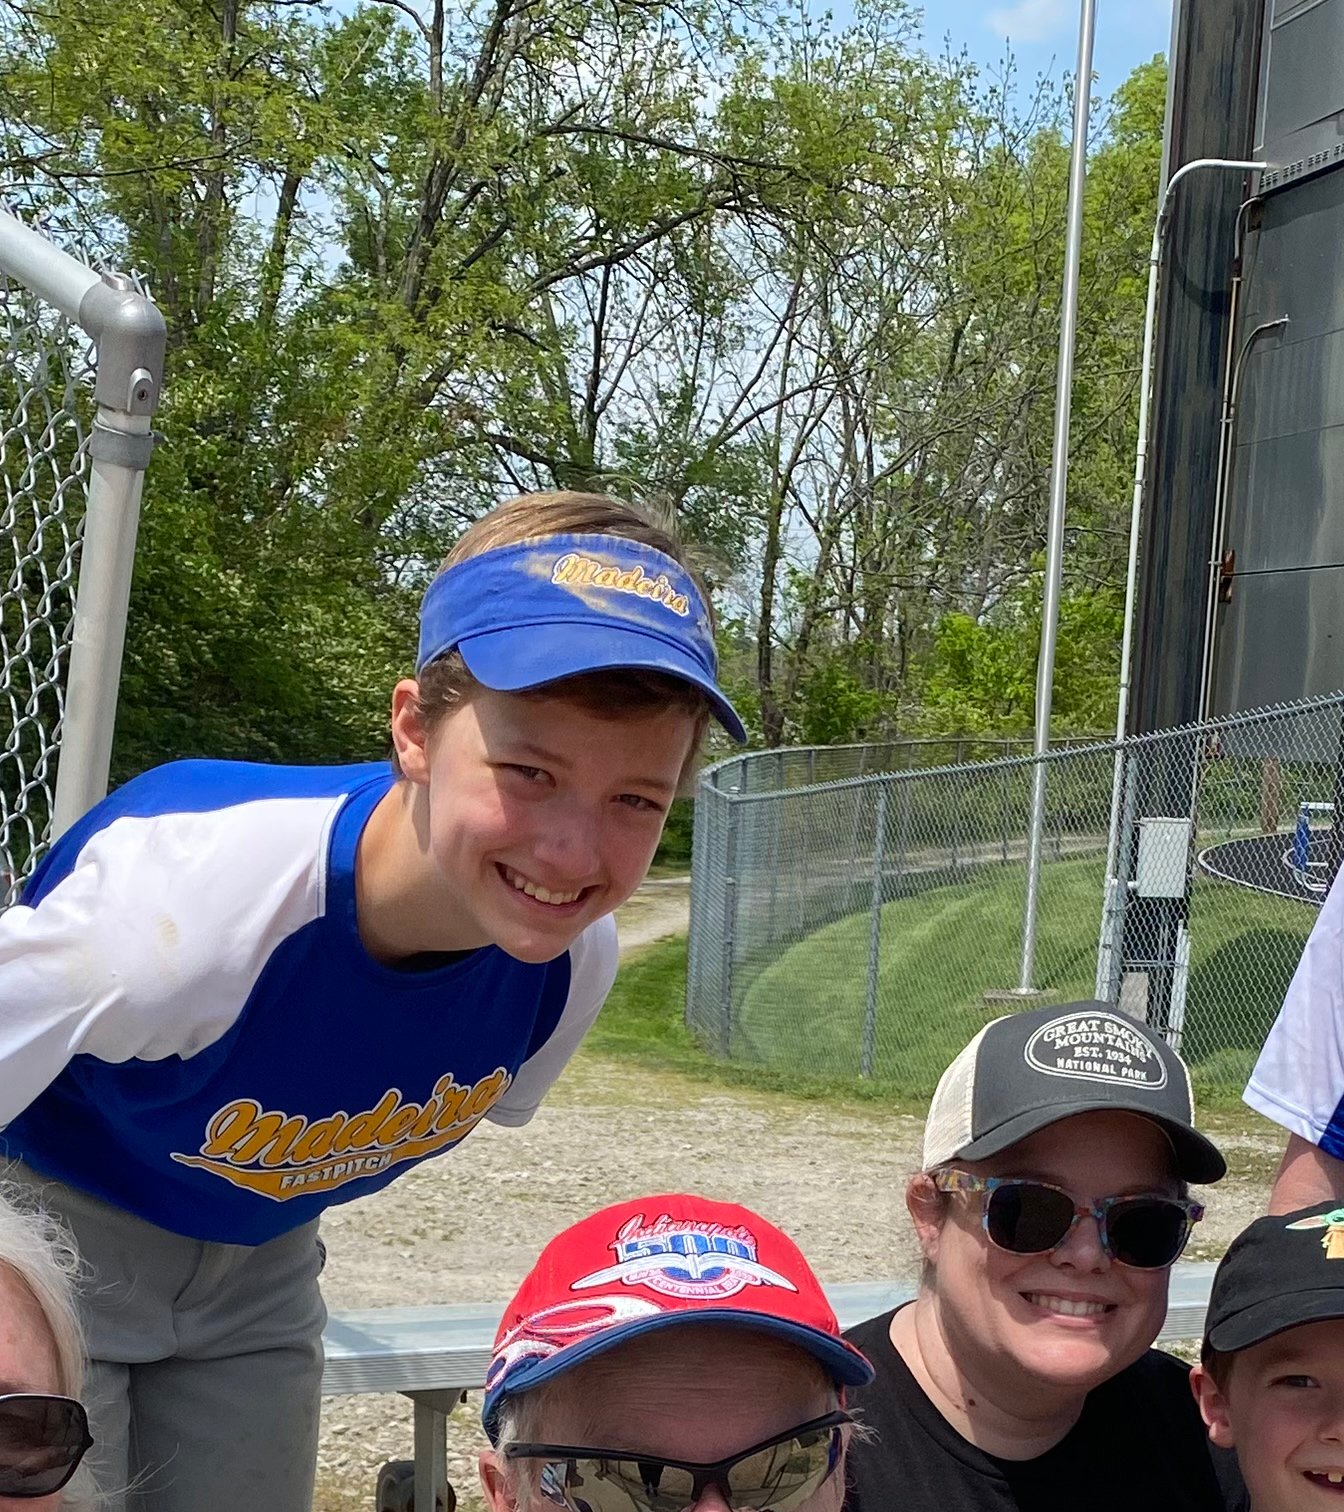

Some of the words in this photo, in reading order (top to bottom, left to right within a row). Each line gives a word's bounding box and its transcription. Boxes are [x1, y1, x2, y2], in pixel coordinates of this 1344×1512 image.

[551, 553, 690, 617] Madeira
[1042, 1019, 1101, 1043] GREAT
[1103, 1021, 1154, 1060] SMOKY
[1053, 1031, 1147, 1064] MOUNTAINS
[1073, 1046, 1104, 1059] EST.
[1106, 1048, 1133, 1066] 1934
[1056, 1057, 1117, 1075] NATIONAL
[1120, 1067, 1148, 1082] PARK
[199, 1066, 512, 1168] Madeira
[280, 1153, 393, 1192] FASTPITCH
[615, 1232, 757, 1263] 500
